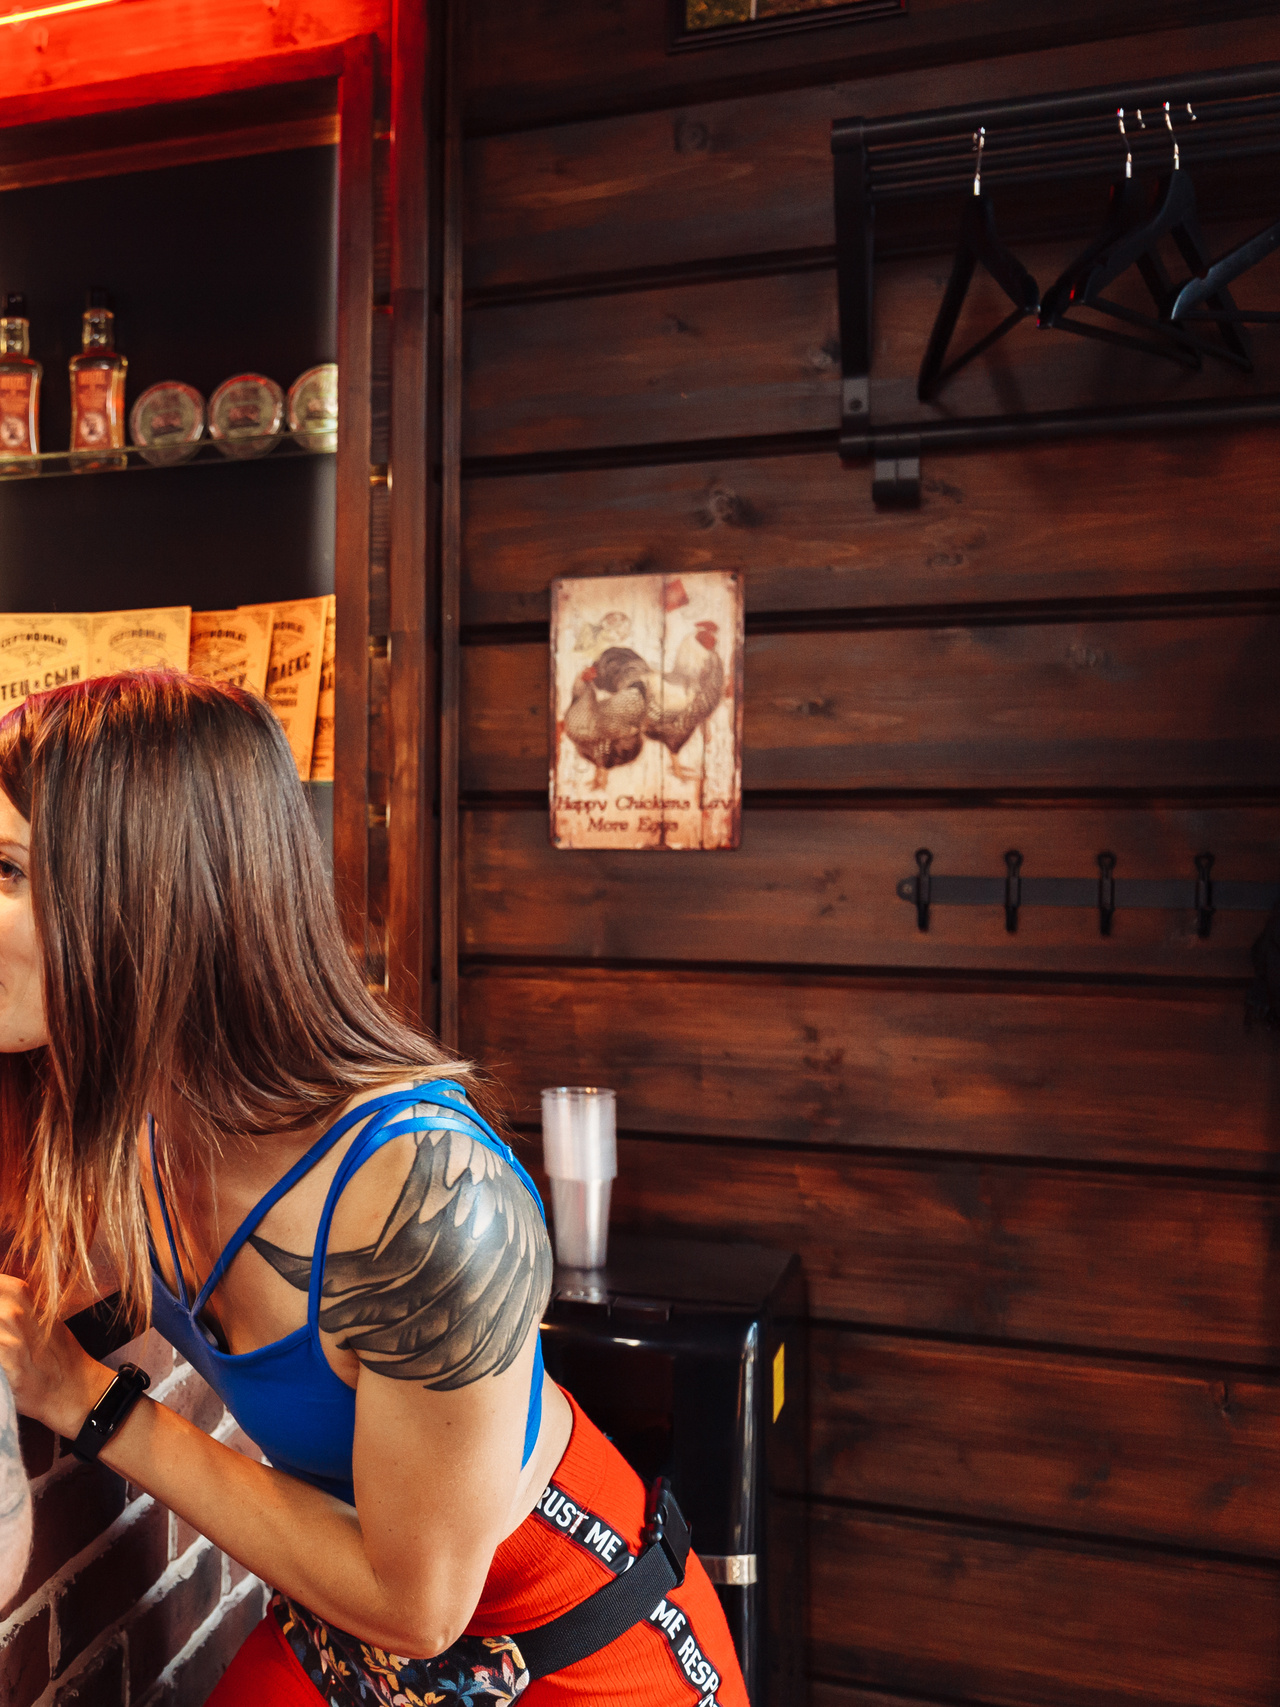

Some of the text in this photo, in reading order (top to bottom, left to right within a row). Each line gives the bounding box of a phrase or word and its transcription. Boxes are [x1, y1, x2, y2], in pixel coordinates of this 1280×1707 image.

[44, 665, 80, 687] СЫН
[558, 795, 607, 815] Happy
[587, 816, 629, 833] More
[583, 1521, 623, 1563] ME
[649, 1599, 687, 1641] ME
